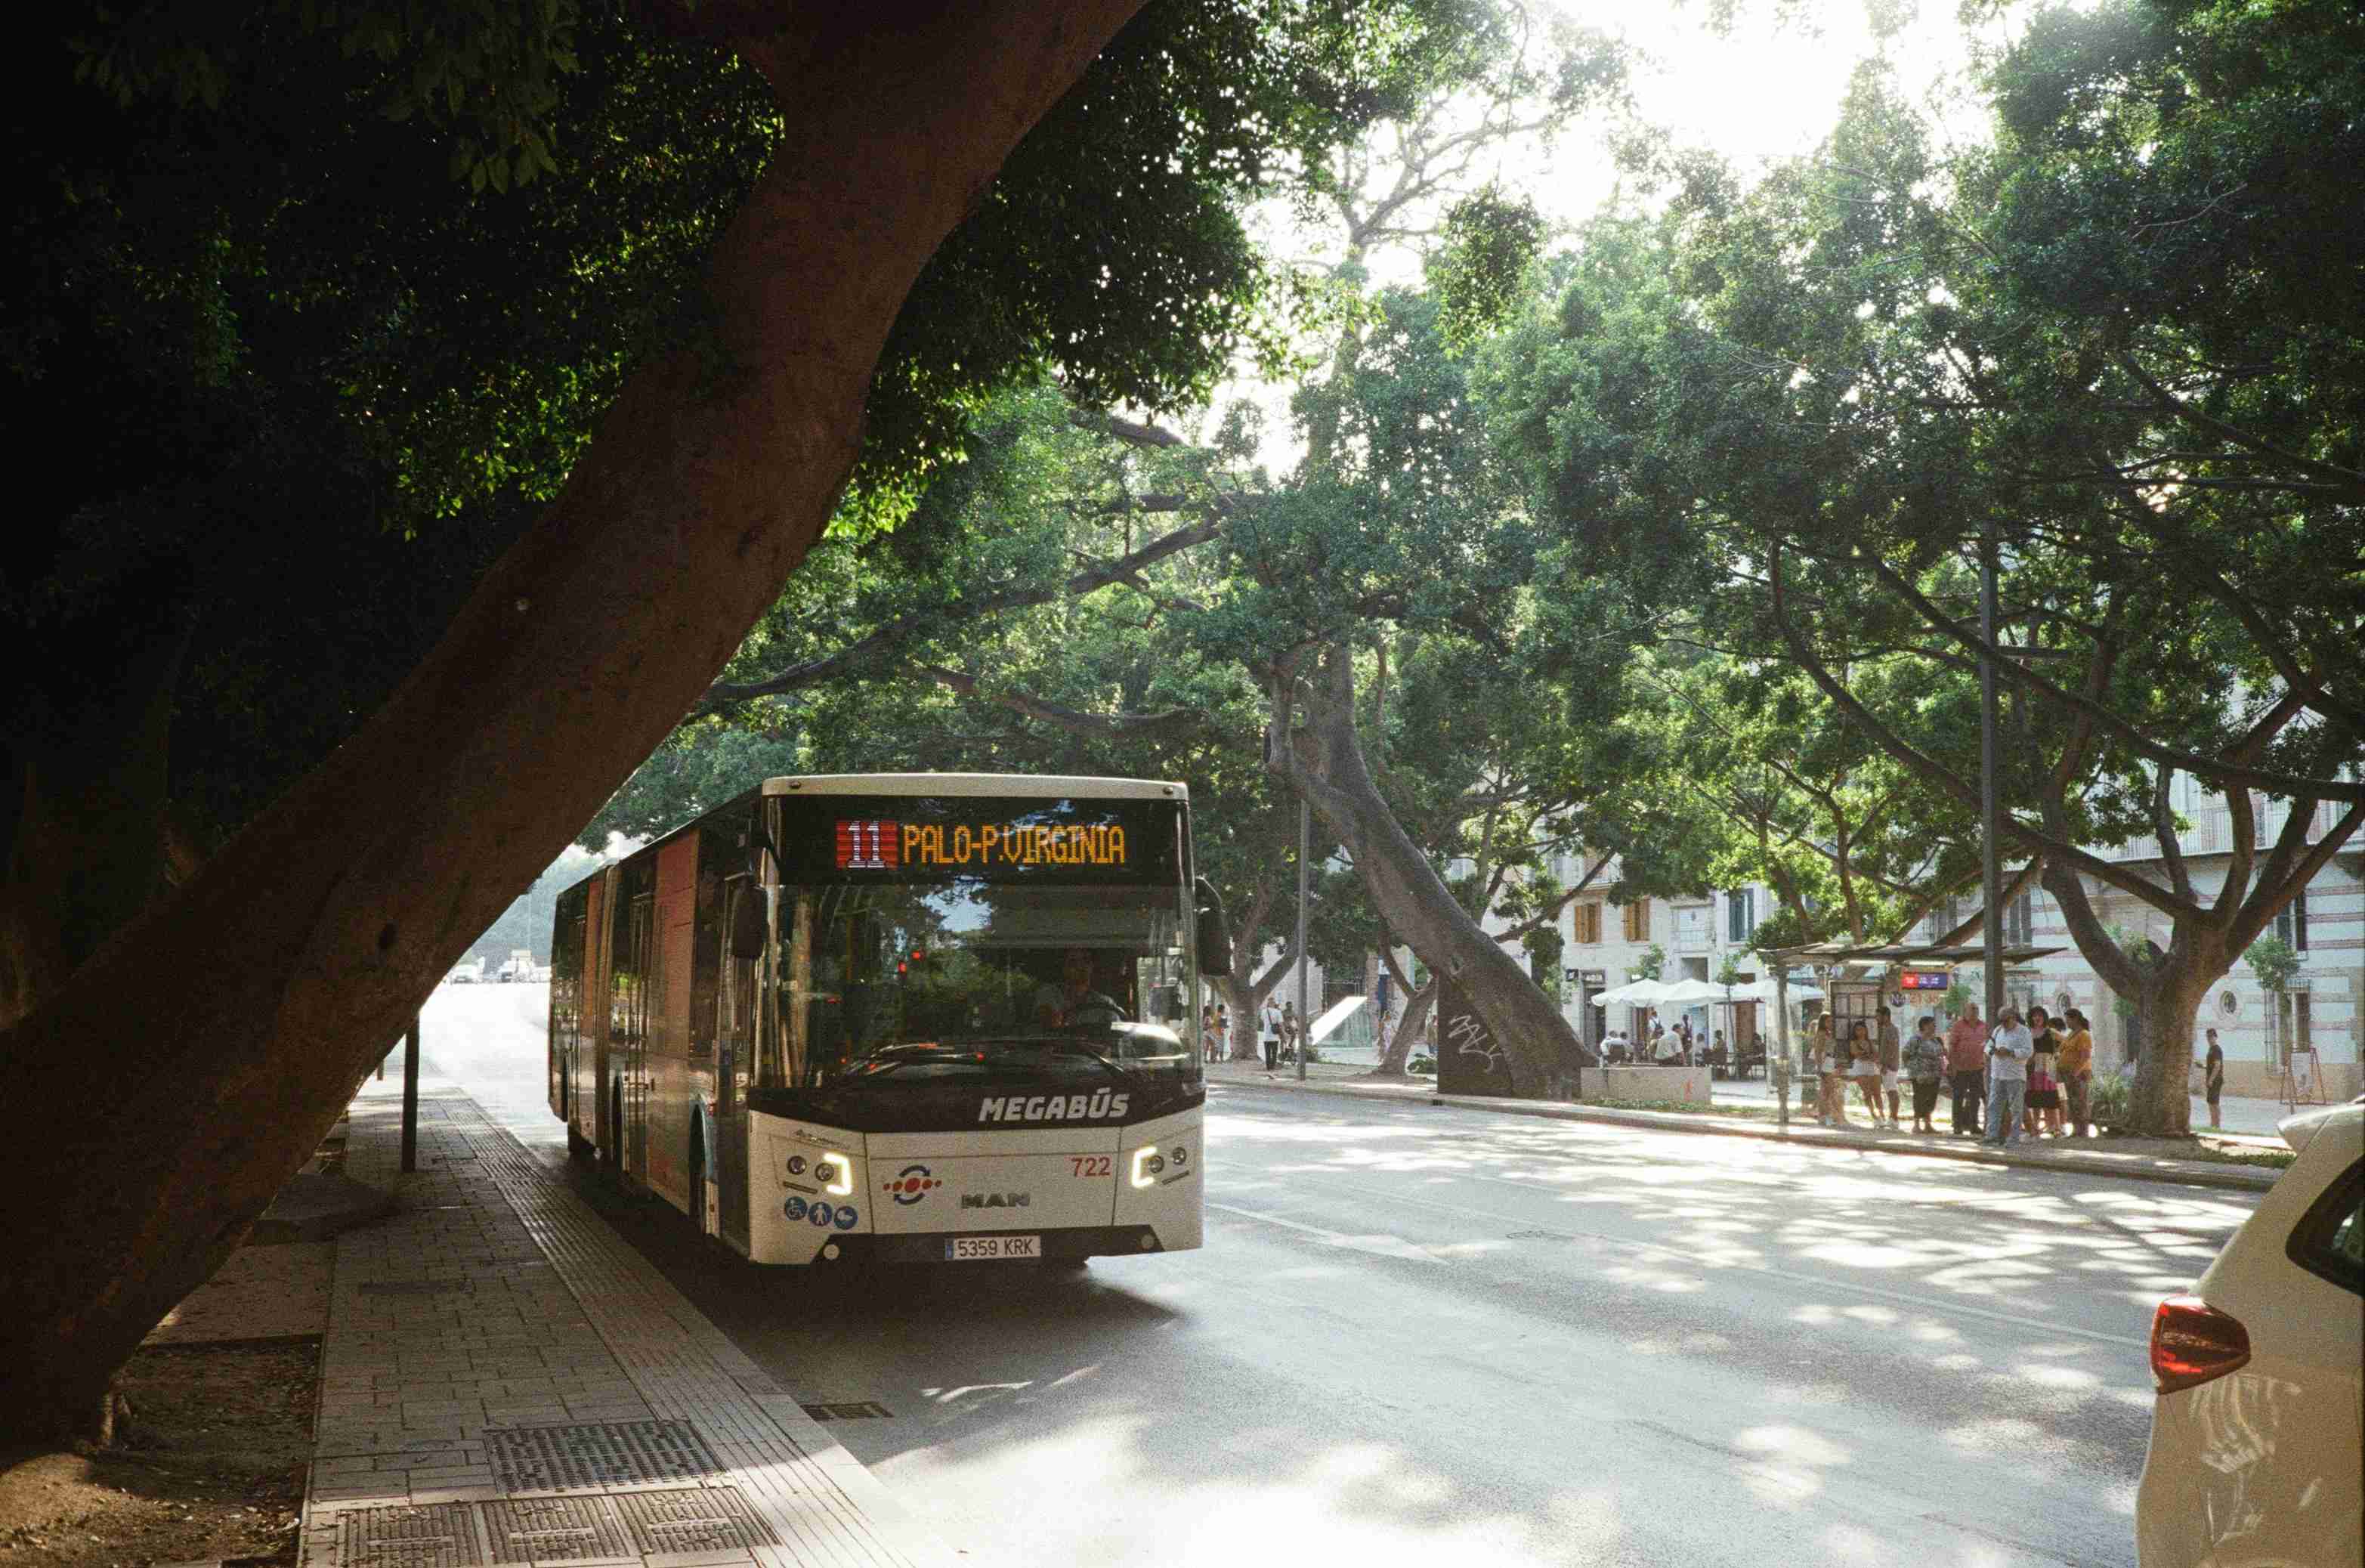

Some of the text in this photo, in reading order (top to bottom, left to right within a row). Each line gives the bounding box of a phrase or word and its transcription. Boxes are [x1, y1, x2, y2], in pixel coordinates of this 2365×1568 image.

[848, 821, 1126, 868] 11 PALO-P.VIRGINIA
[978, 1087, 1130, 1122] MEGABÚS
[1071, 1157, 1111, 1177] 722
[961, 1193, 1030, 1209] MAN
[958, 1239, 1034, 1257] 5359 KRK
